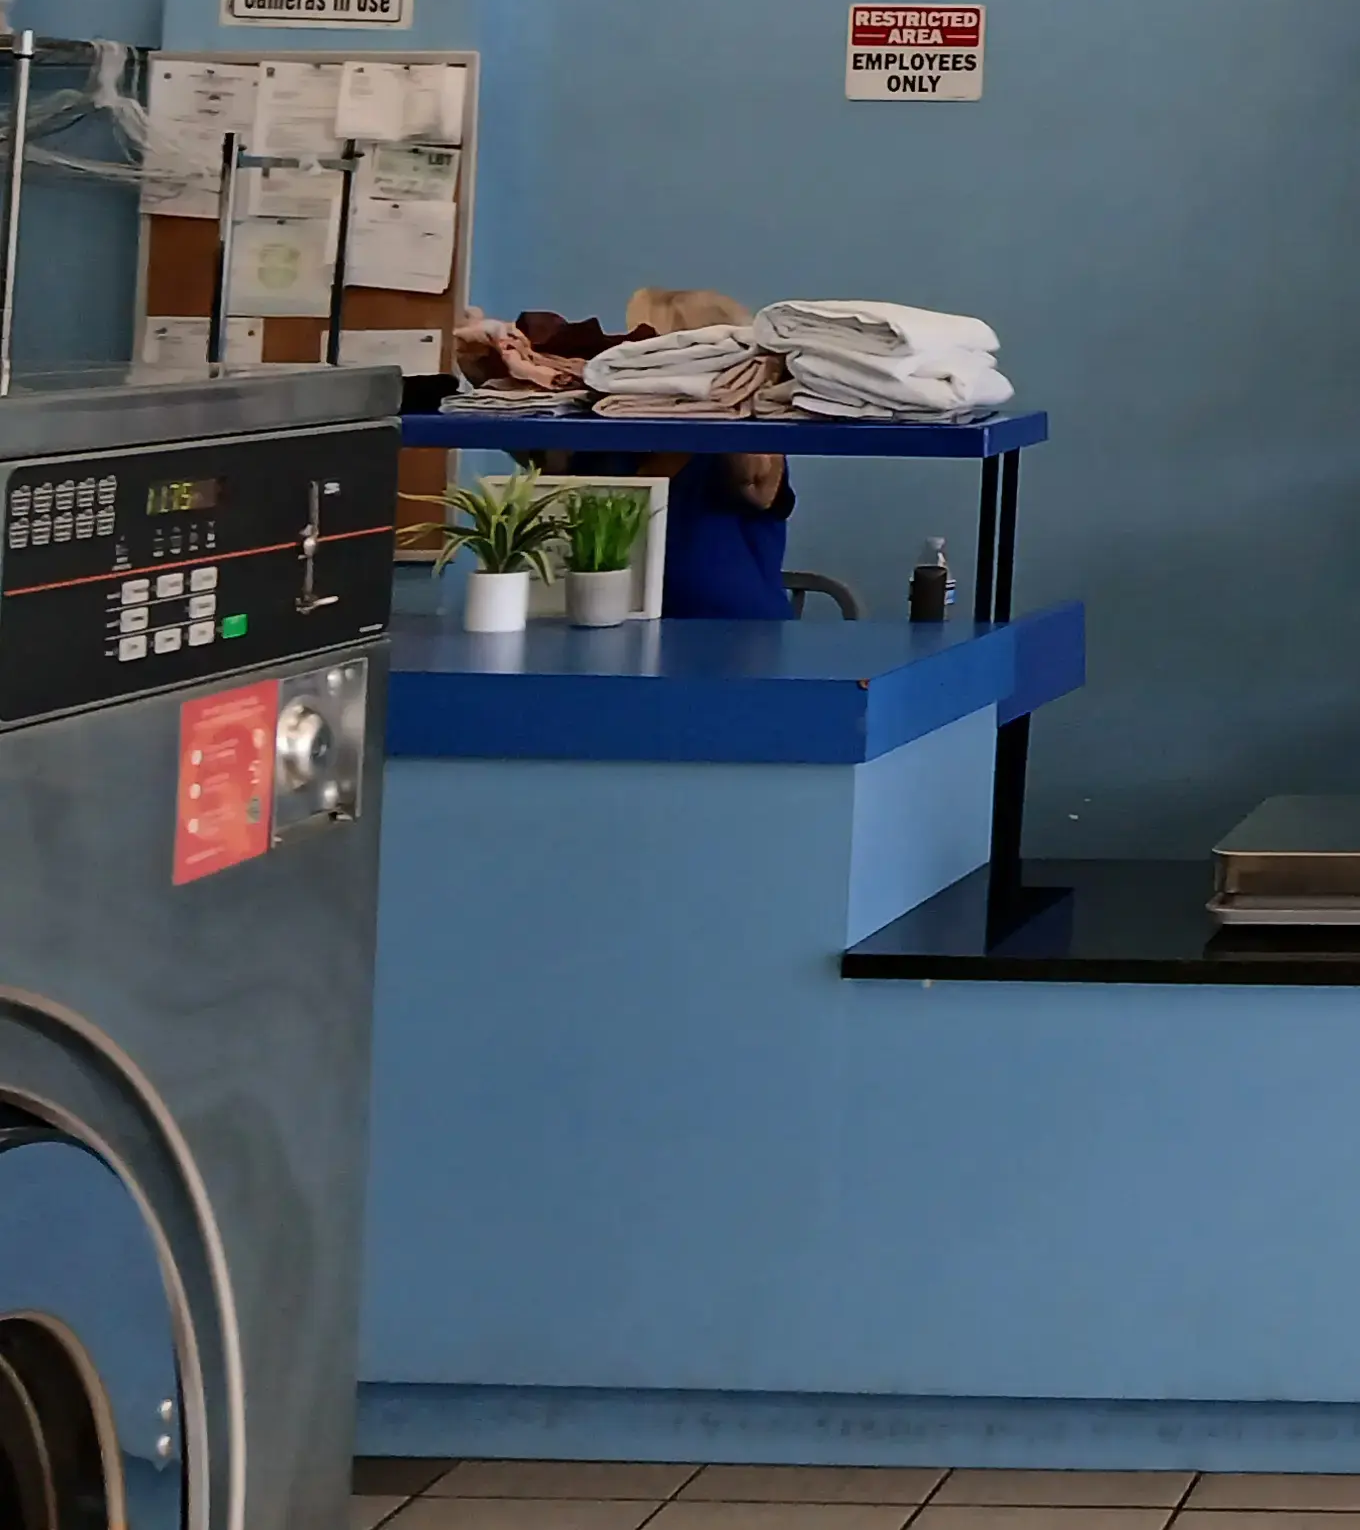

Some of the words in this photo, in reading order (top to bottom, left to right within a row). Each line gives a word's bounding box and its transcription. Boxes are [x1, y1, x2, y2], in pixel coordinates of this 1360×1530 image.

[855, 10, 978, 27] RESTRICTED
[888, 28, 943, 44] AREA
[852, 53, 977, 71] EMPLOYEES
[887, 75, 941, 93] ONLY
